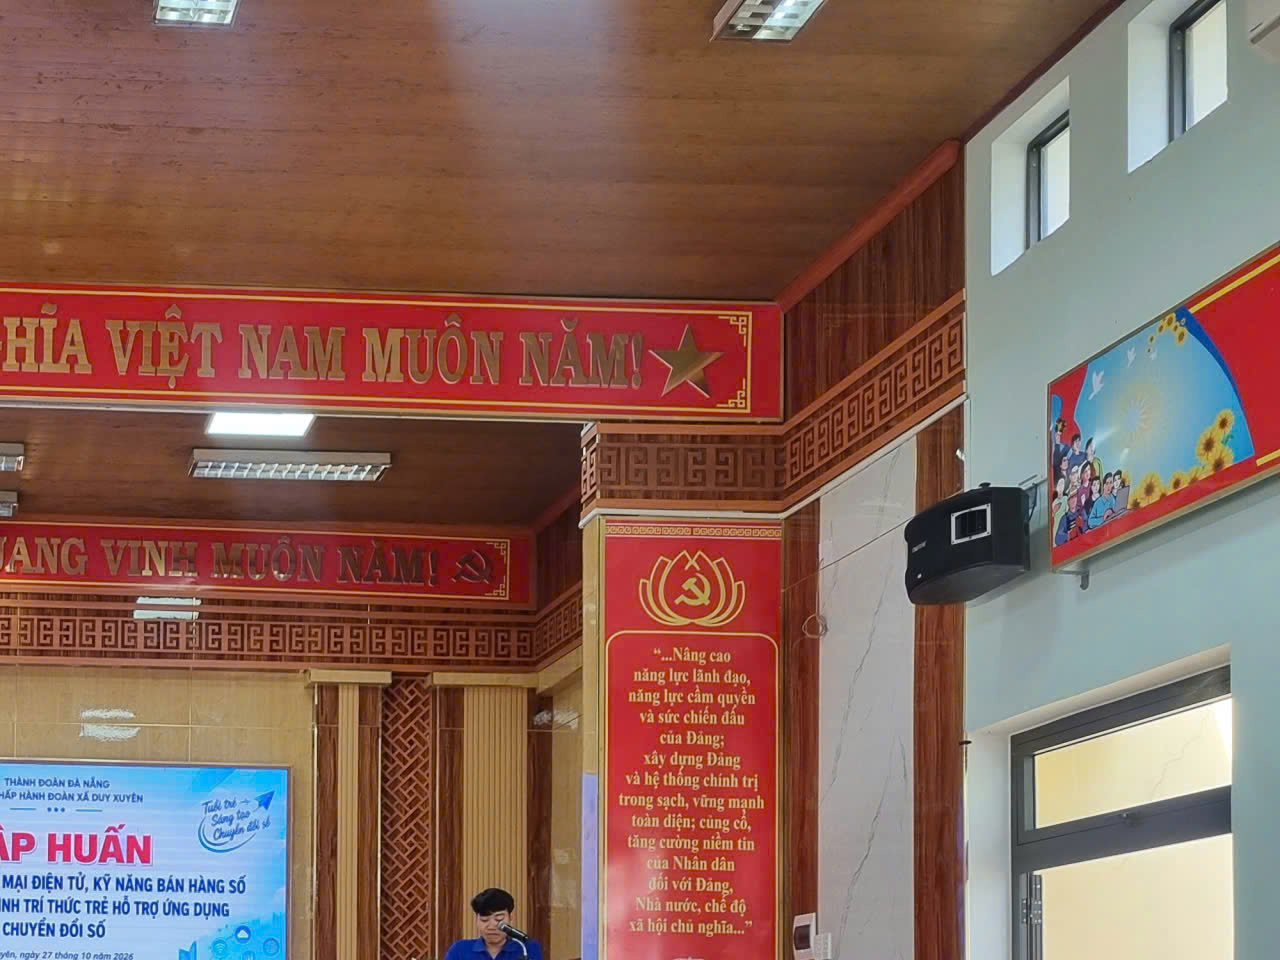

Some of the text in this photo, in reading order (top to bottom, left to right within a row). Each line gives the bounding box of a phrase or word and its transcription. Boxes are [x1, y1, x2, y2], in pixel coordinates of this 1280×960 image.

[105, 303, 222, 388] VIỆT
[239, 323, 345, 381] NAM
[361, 312, 503, 384] MUÔN
[518, 316, 641, 389] NĂM!
[100, 538, 199, 578] VINH
[210, 535, 327, 582] MUÔN
[710, 651, 731, 662] cao
[634, 668, 751, 687] năng lực lãnh đạo,
[628, 685, 755, 708] năng lực cầm quyền
[640, 705, 745, 725] và sức chiến đấu
[660, 730, 725, 749] của Đảng;
[643, 750, 740, 771] xây dựng Đảng
[4, 776, 36, 788] THÀNH
[38, 777, 65, 788] ĐOÀN
[67, 777, 81, 788] ĐÀ
[625, 766, 759, 792] và hệ thống chính trị
[20, 791, 46, 801] HÀNH
[48, 791, 74, 801] ĐOÀN
[92, 793, 110, 802] DUY
[112, 793, 144, 803] XUYÊN
[618, 793, 653, 810] trong
[657, 793, 688, 810] sạch,
[692, 794, 724, 812] vững
[47, 823, 152, 865] HUẤN
[2, 875, 28, 893] MẠI
[31, 872, 63, 894] ĐIỆN
[67, 872, 89, 893] TỬ,
[93, 873, 111, 891] KỸ
[115, 874, 153, 892] NĂNG
[157, 874, 185, 893] BÁN
[188, 875, 225, 894] HÀNG
[228, 874, 246, 894] SỐ
[23, 896, 43, 913] TRÍ
[47, 896, 81, 914] THỨC
[85, 896, 109, 914] TRẺ
[112, 895, 130, 915] HỖ
[134, 899, 160, 919] TRỢ
[162, 898, 190, 916] ỨNG
[193, 902, 230, 920] DỤNG
[2, 917, 106, 938] CHUYỂN ĐỔI SỐ
